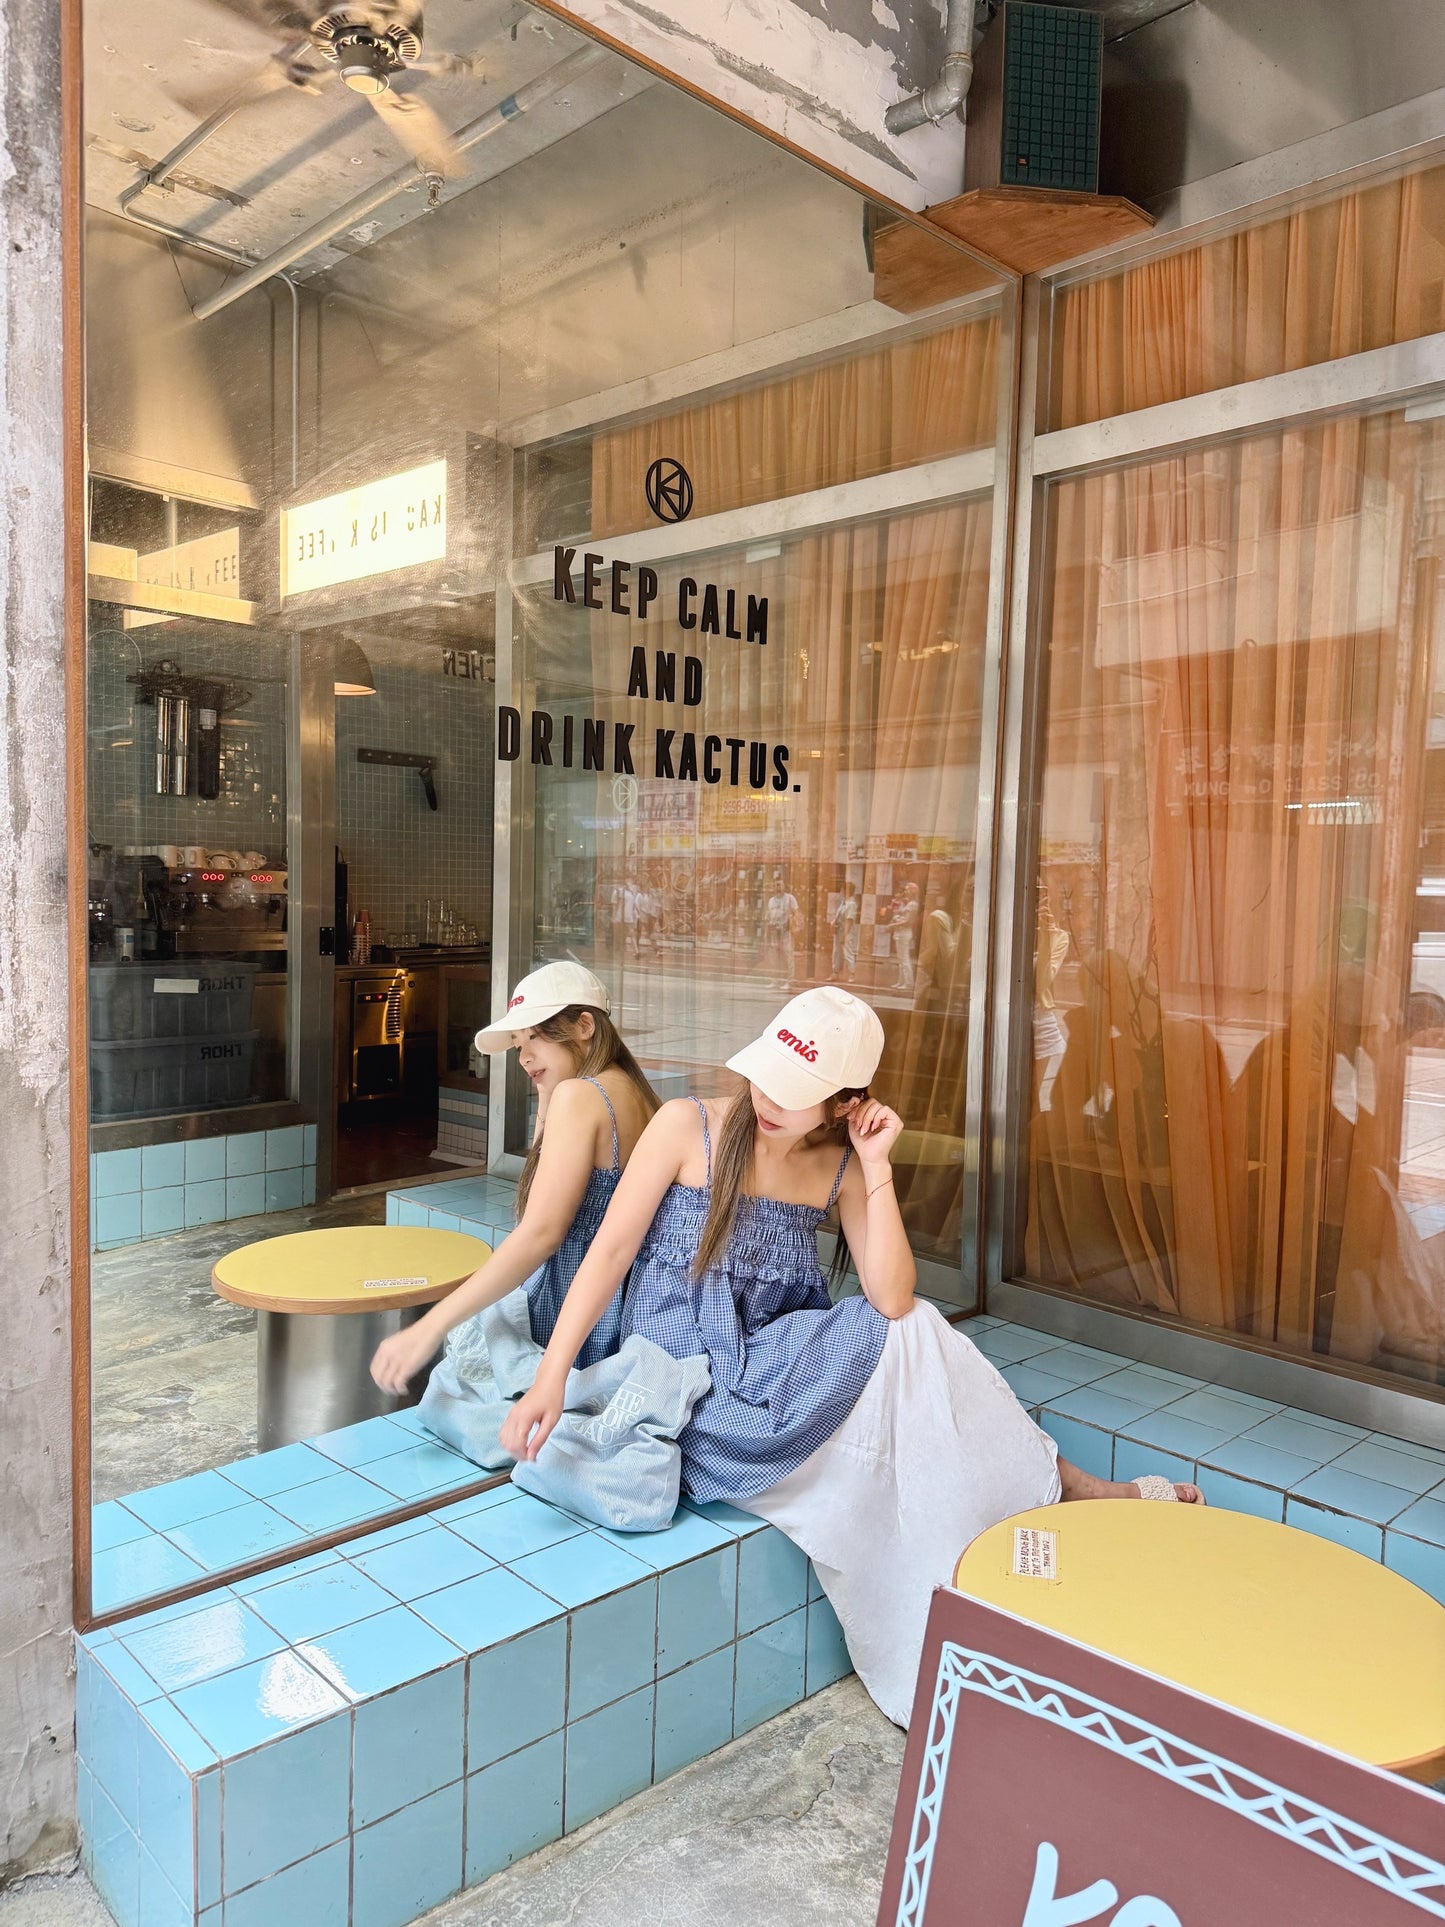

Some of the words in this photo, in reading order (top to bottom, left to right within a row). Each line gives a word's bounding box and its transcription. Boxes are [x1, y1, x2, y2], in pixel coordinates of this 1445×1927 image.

[554, 545, 658, 619] KEEP
[679, 577, 769, 645] CALM
[627, 646, 703, 707] AND
[498, 706, 636, 775] DRINK
[655, 728, 802, 793] KACTUS.
[777, 1026, 819, 1064] emis
